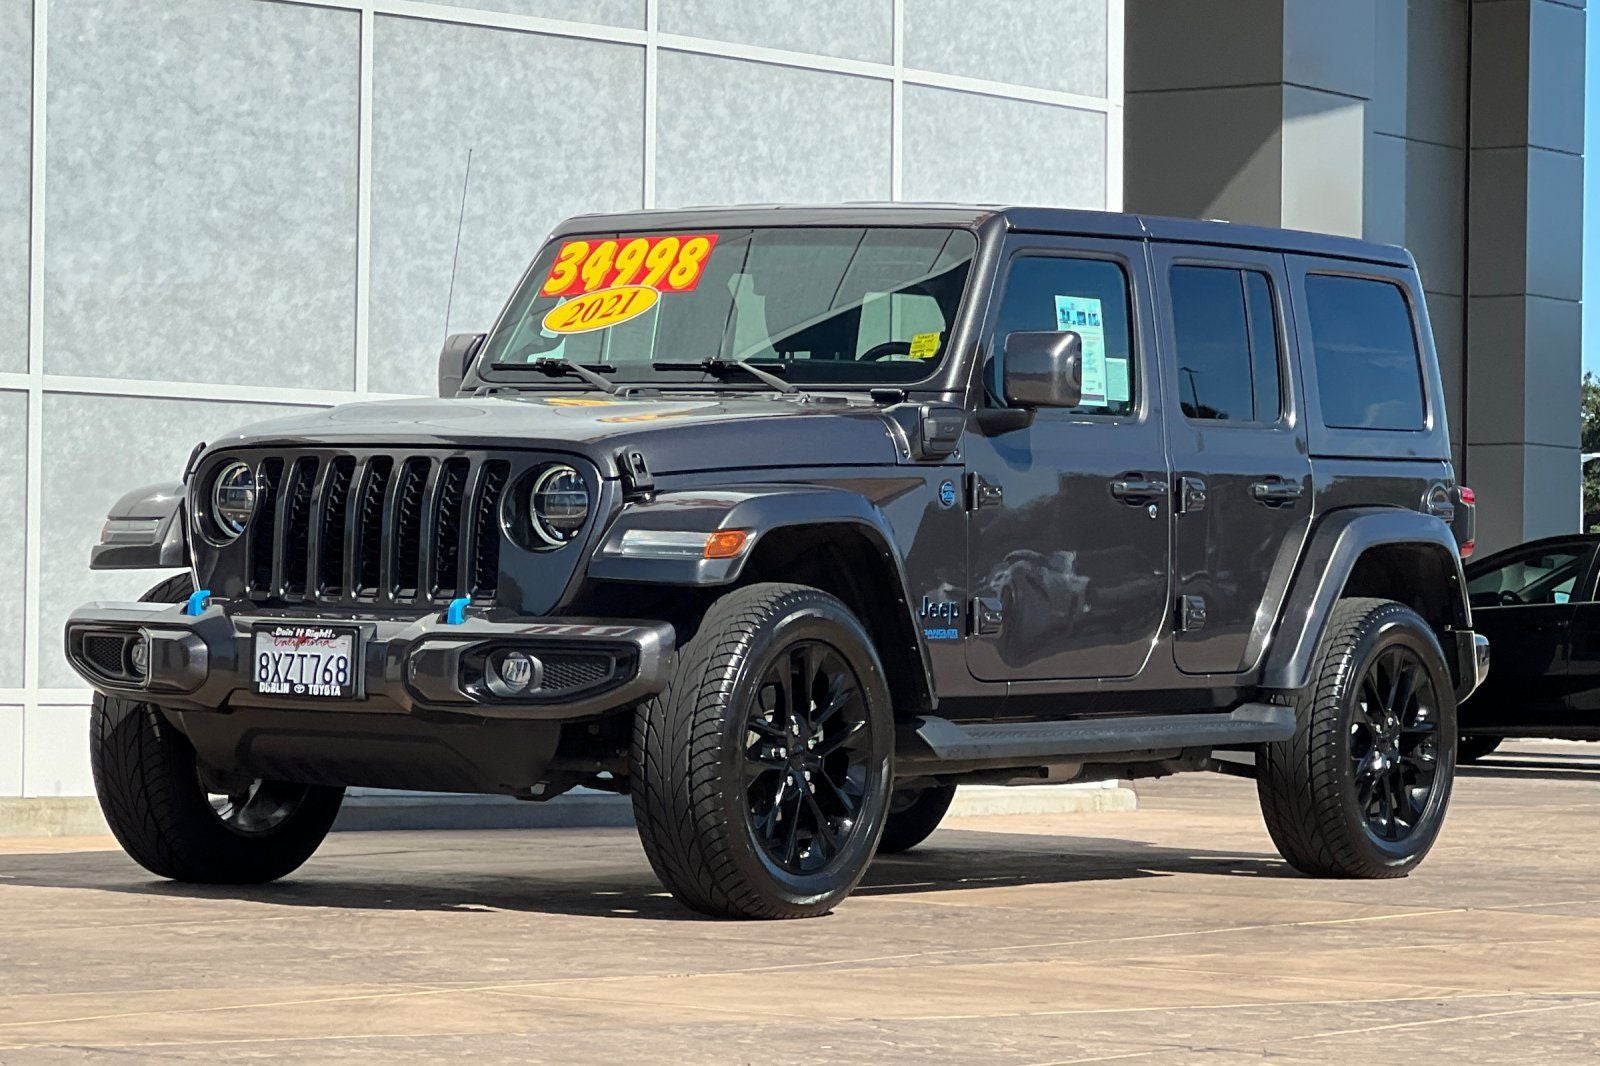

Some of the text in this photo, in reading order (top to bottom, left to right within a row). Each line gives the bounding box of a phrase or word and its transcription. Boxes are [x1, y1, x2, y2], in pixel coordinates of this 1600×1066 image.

[543, 236, 711, 294] 34998
[560, 289, 641, 328] 2021
[919, 594, 959, 626] Jeep
[259, 652, 348, 685] 8XZT768
[259, 681, 341, 697] DUBLIN TOYOTA
